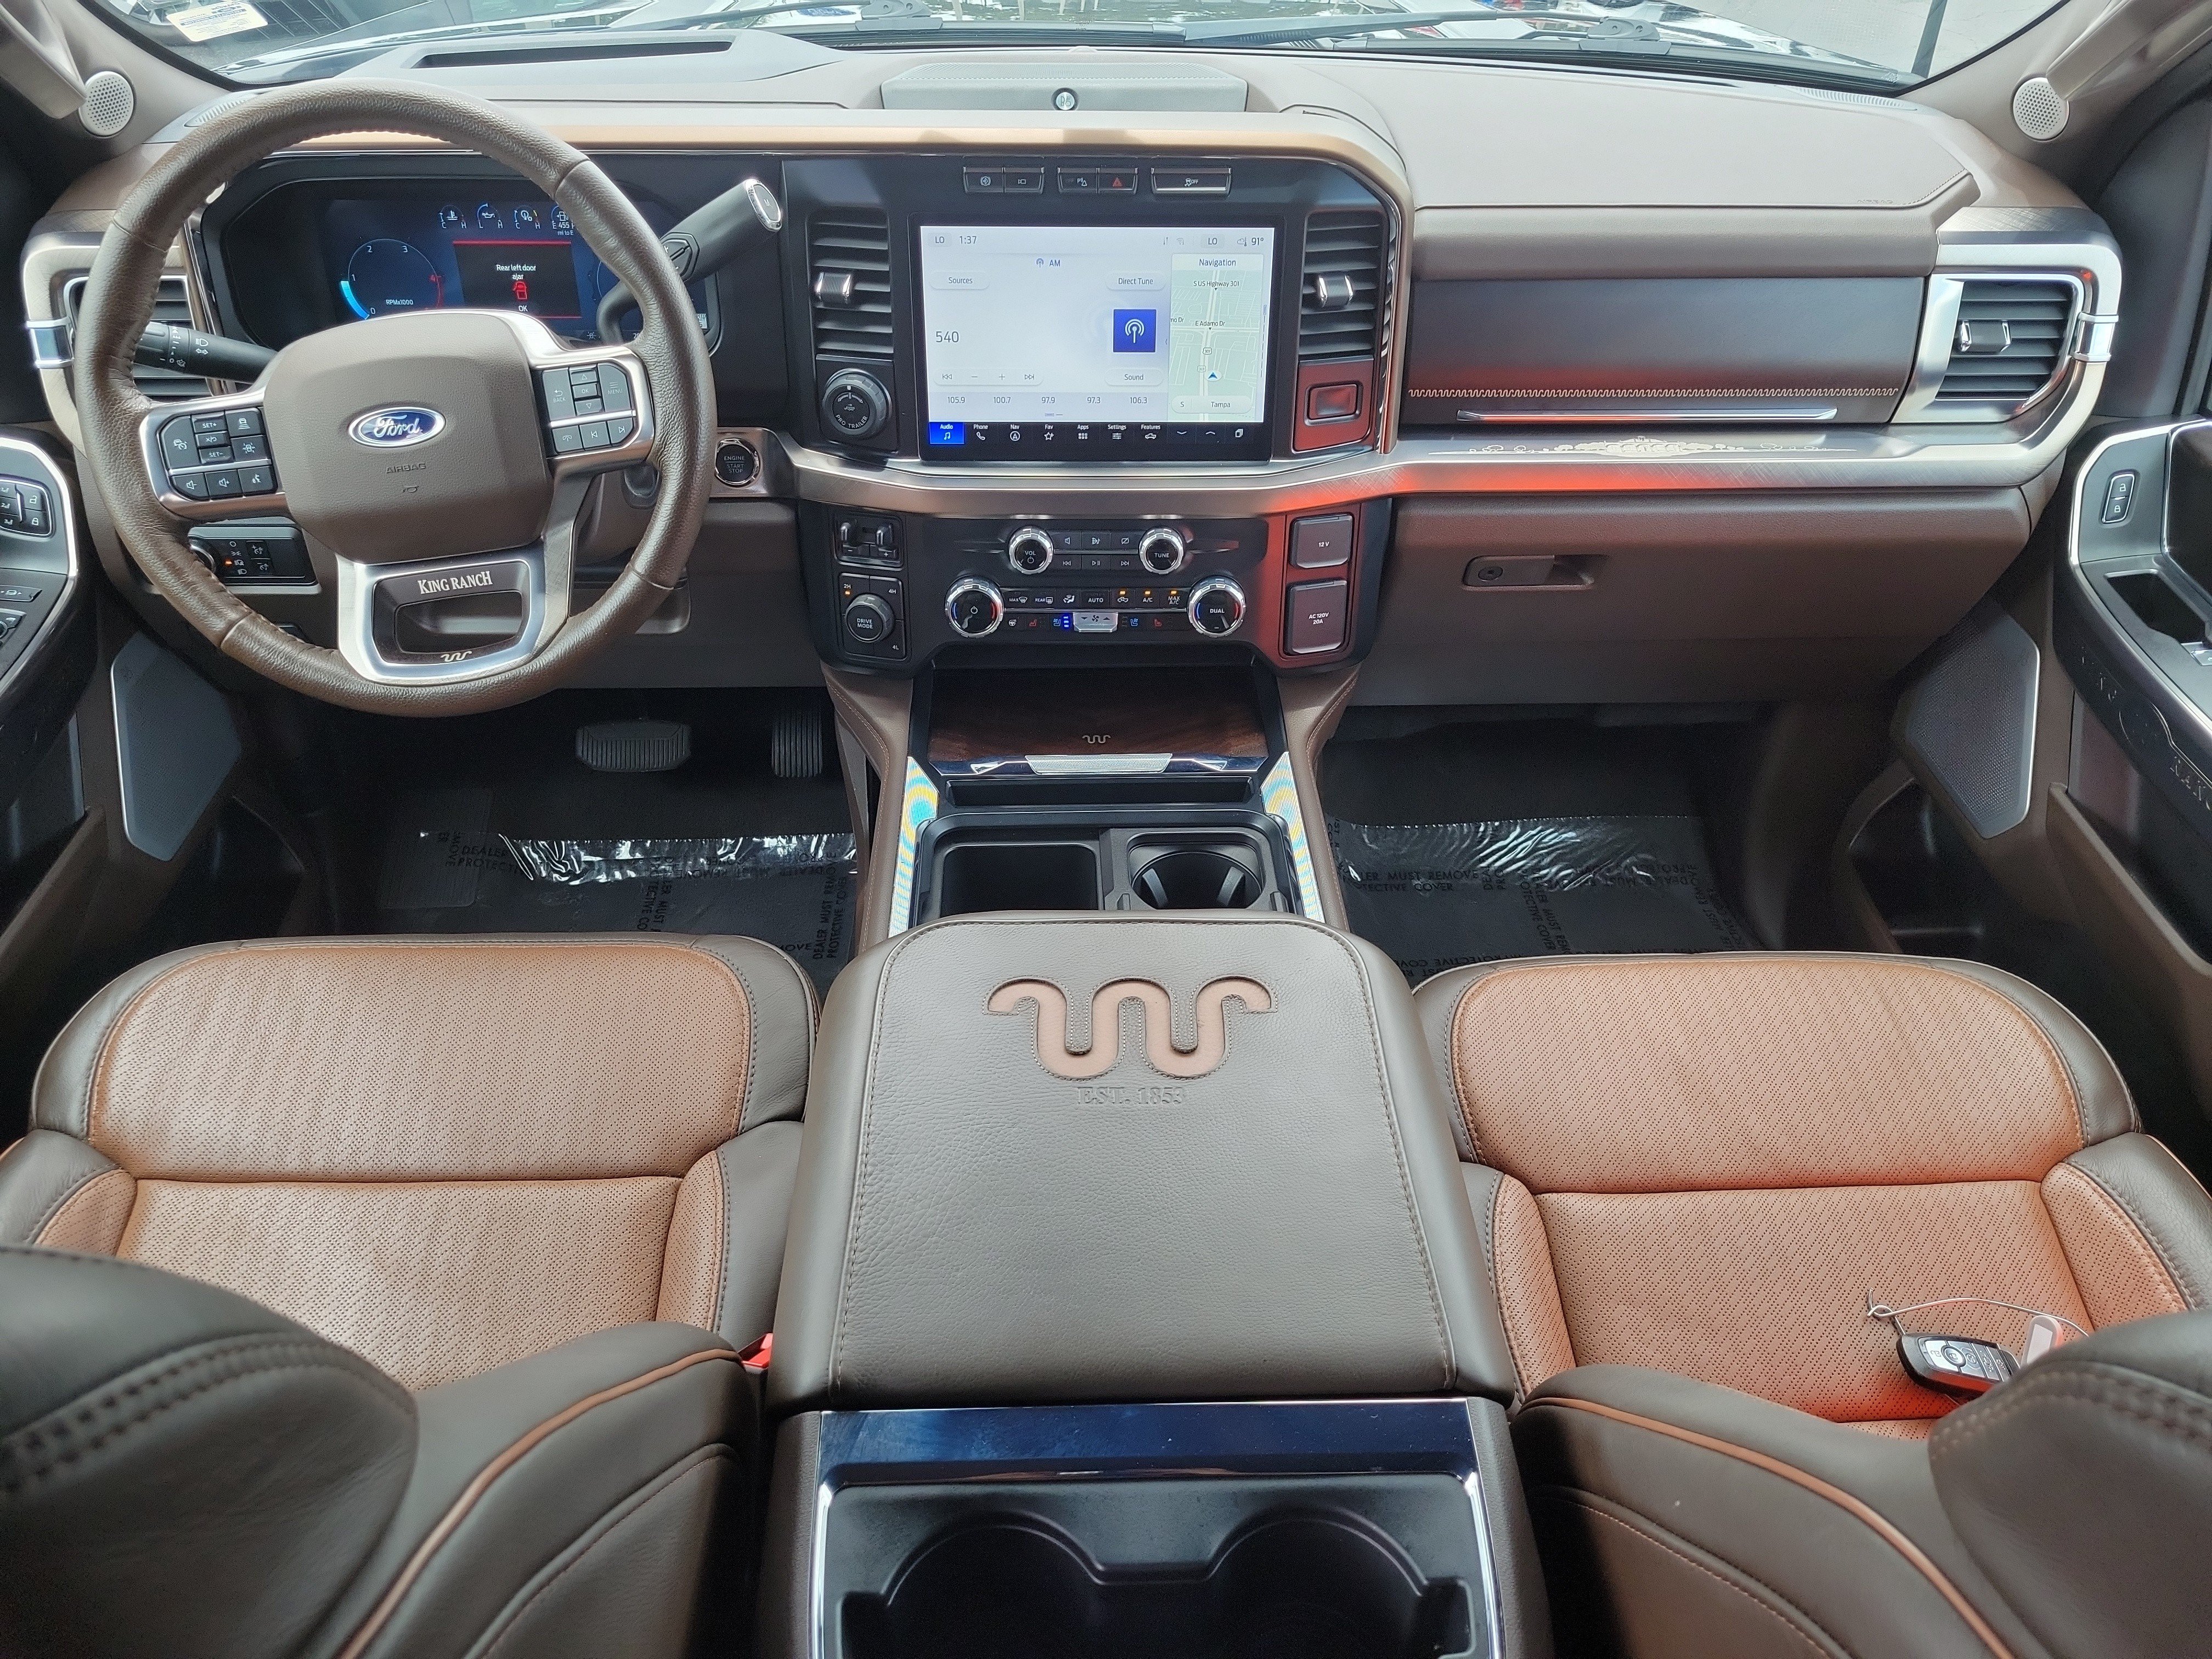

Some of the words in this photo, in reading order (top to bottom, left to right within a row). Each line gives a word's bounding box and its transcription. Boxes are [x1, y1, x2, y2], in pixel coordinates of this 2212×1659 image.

[959, 235, 977, 244] 1:37
[1199, 258, 1237, 268] Navigation
[1206, 280, 1229, 289] Highway
[935, 331, 959, 343] 540
[373, 414, 421, 438] Ford
[835, 414, 846, 426] PRO
[848, 415, 868, 428] TRAILER
[385, 462, 427, 475] AIRBAG
[417, 579, 450, 595] KING
[450, 571, 494, 590] RANCH
[1076, 1087, 1131, 1105] EST.
[1137, 1086, 1185, 1105] 1853
